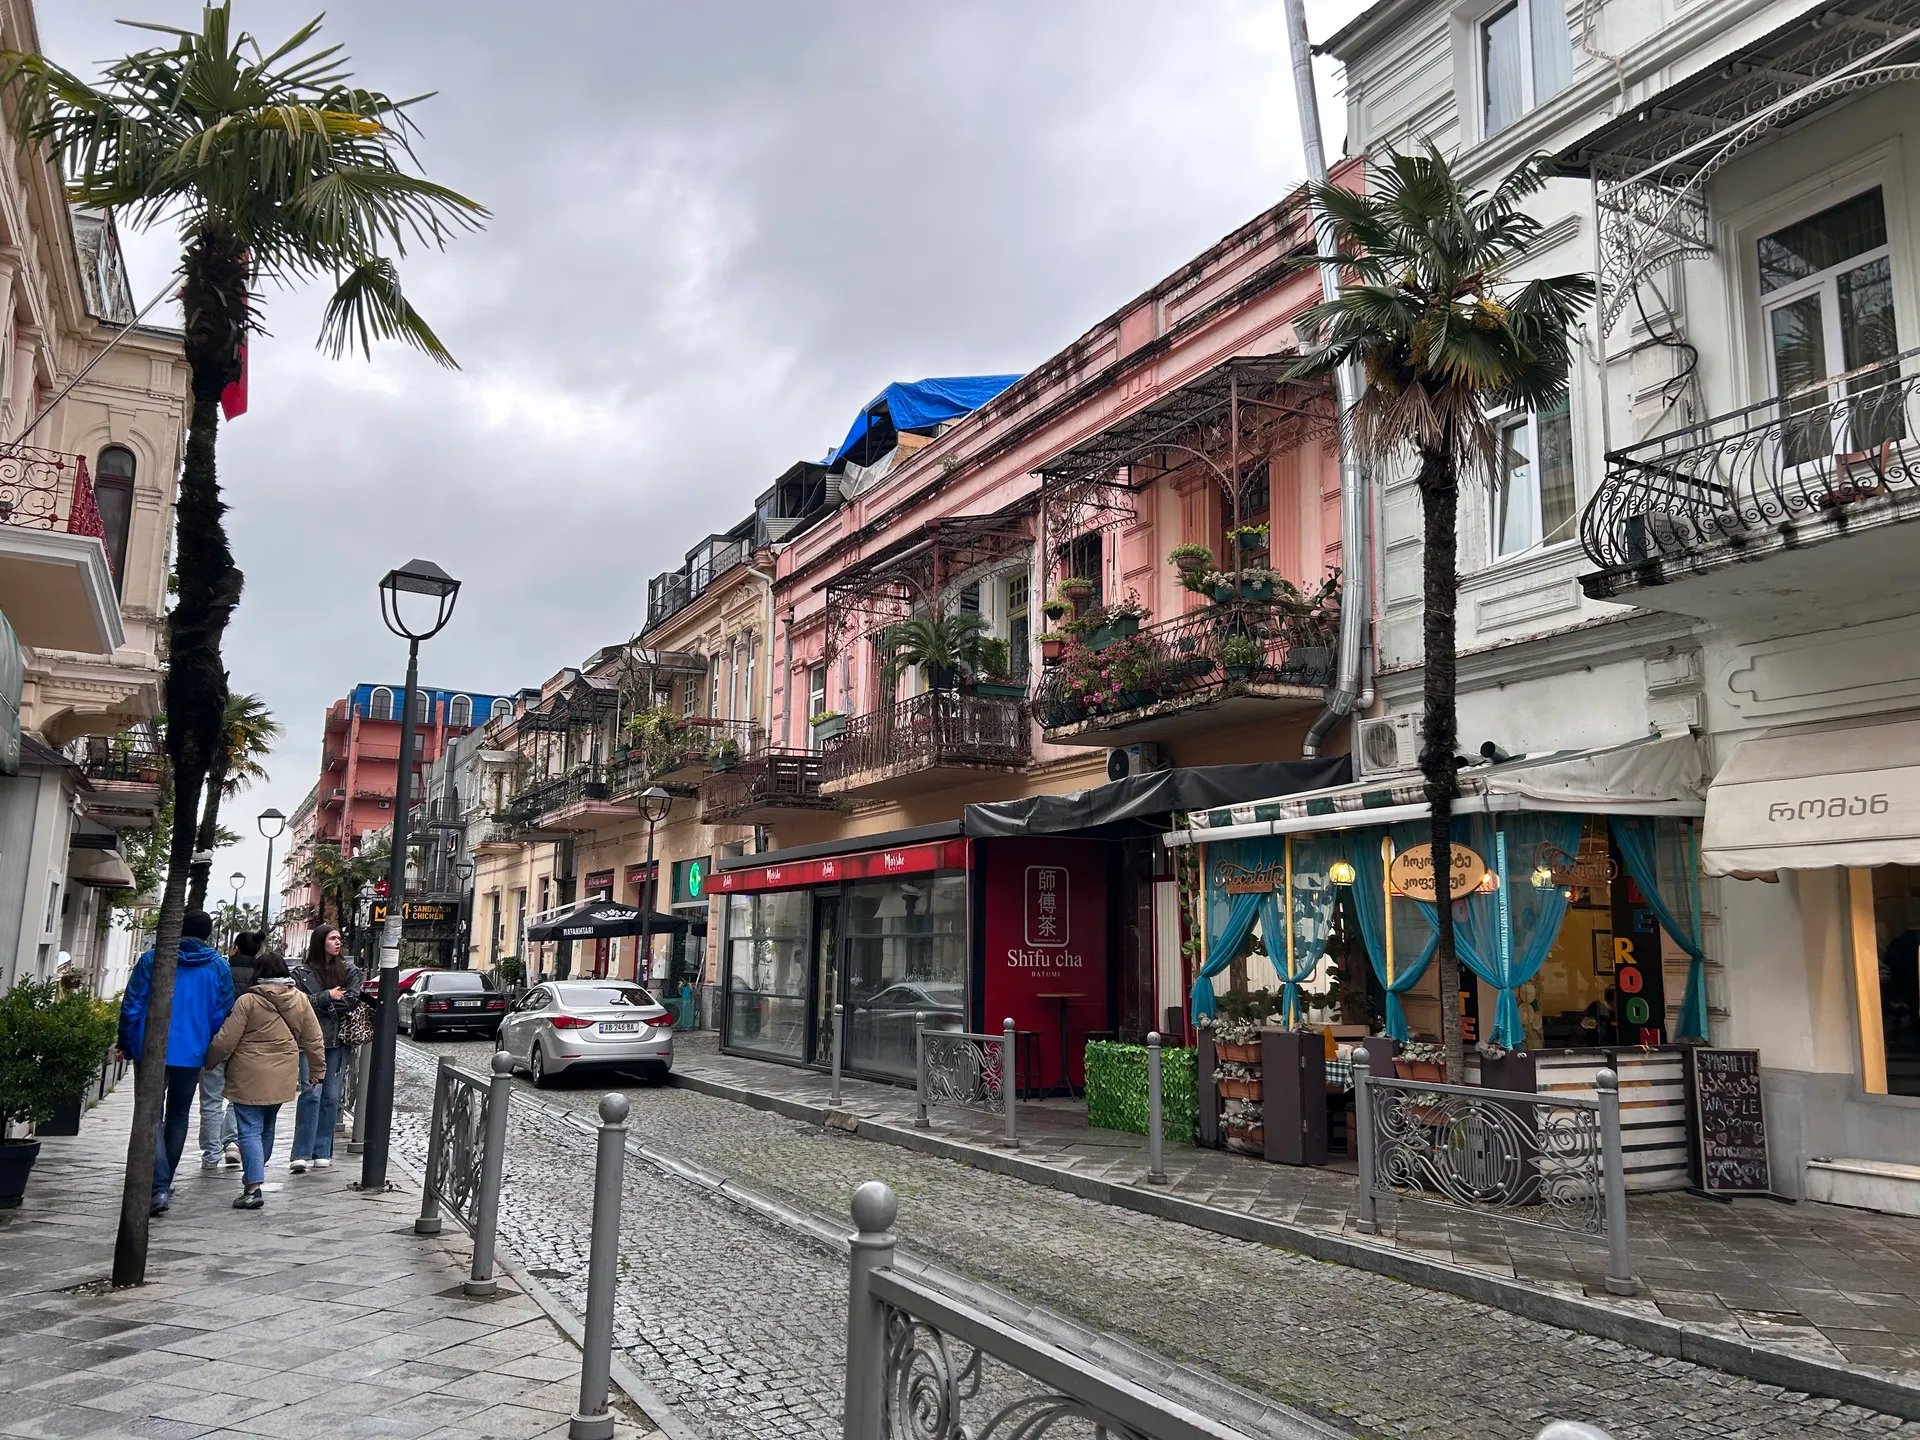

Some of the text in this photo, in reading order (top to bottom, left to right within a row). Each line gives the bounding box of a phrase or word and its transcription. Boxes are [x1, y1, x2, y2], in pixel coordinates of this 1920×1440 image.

[1768, 793, 1889, 822] რომან
[412, 905, 452, 913] SANDWICH
[1038, 869, 1057, 937] 師傅茶
[412, 912, 444, 920] CHICKEN
[1055, 949, 1083, 968] cha
[1701, 1097, 1760, 1115] WAFFLE
